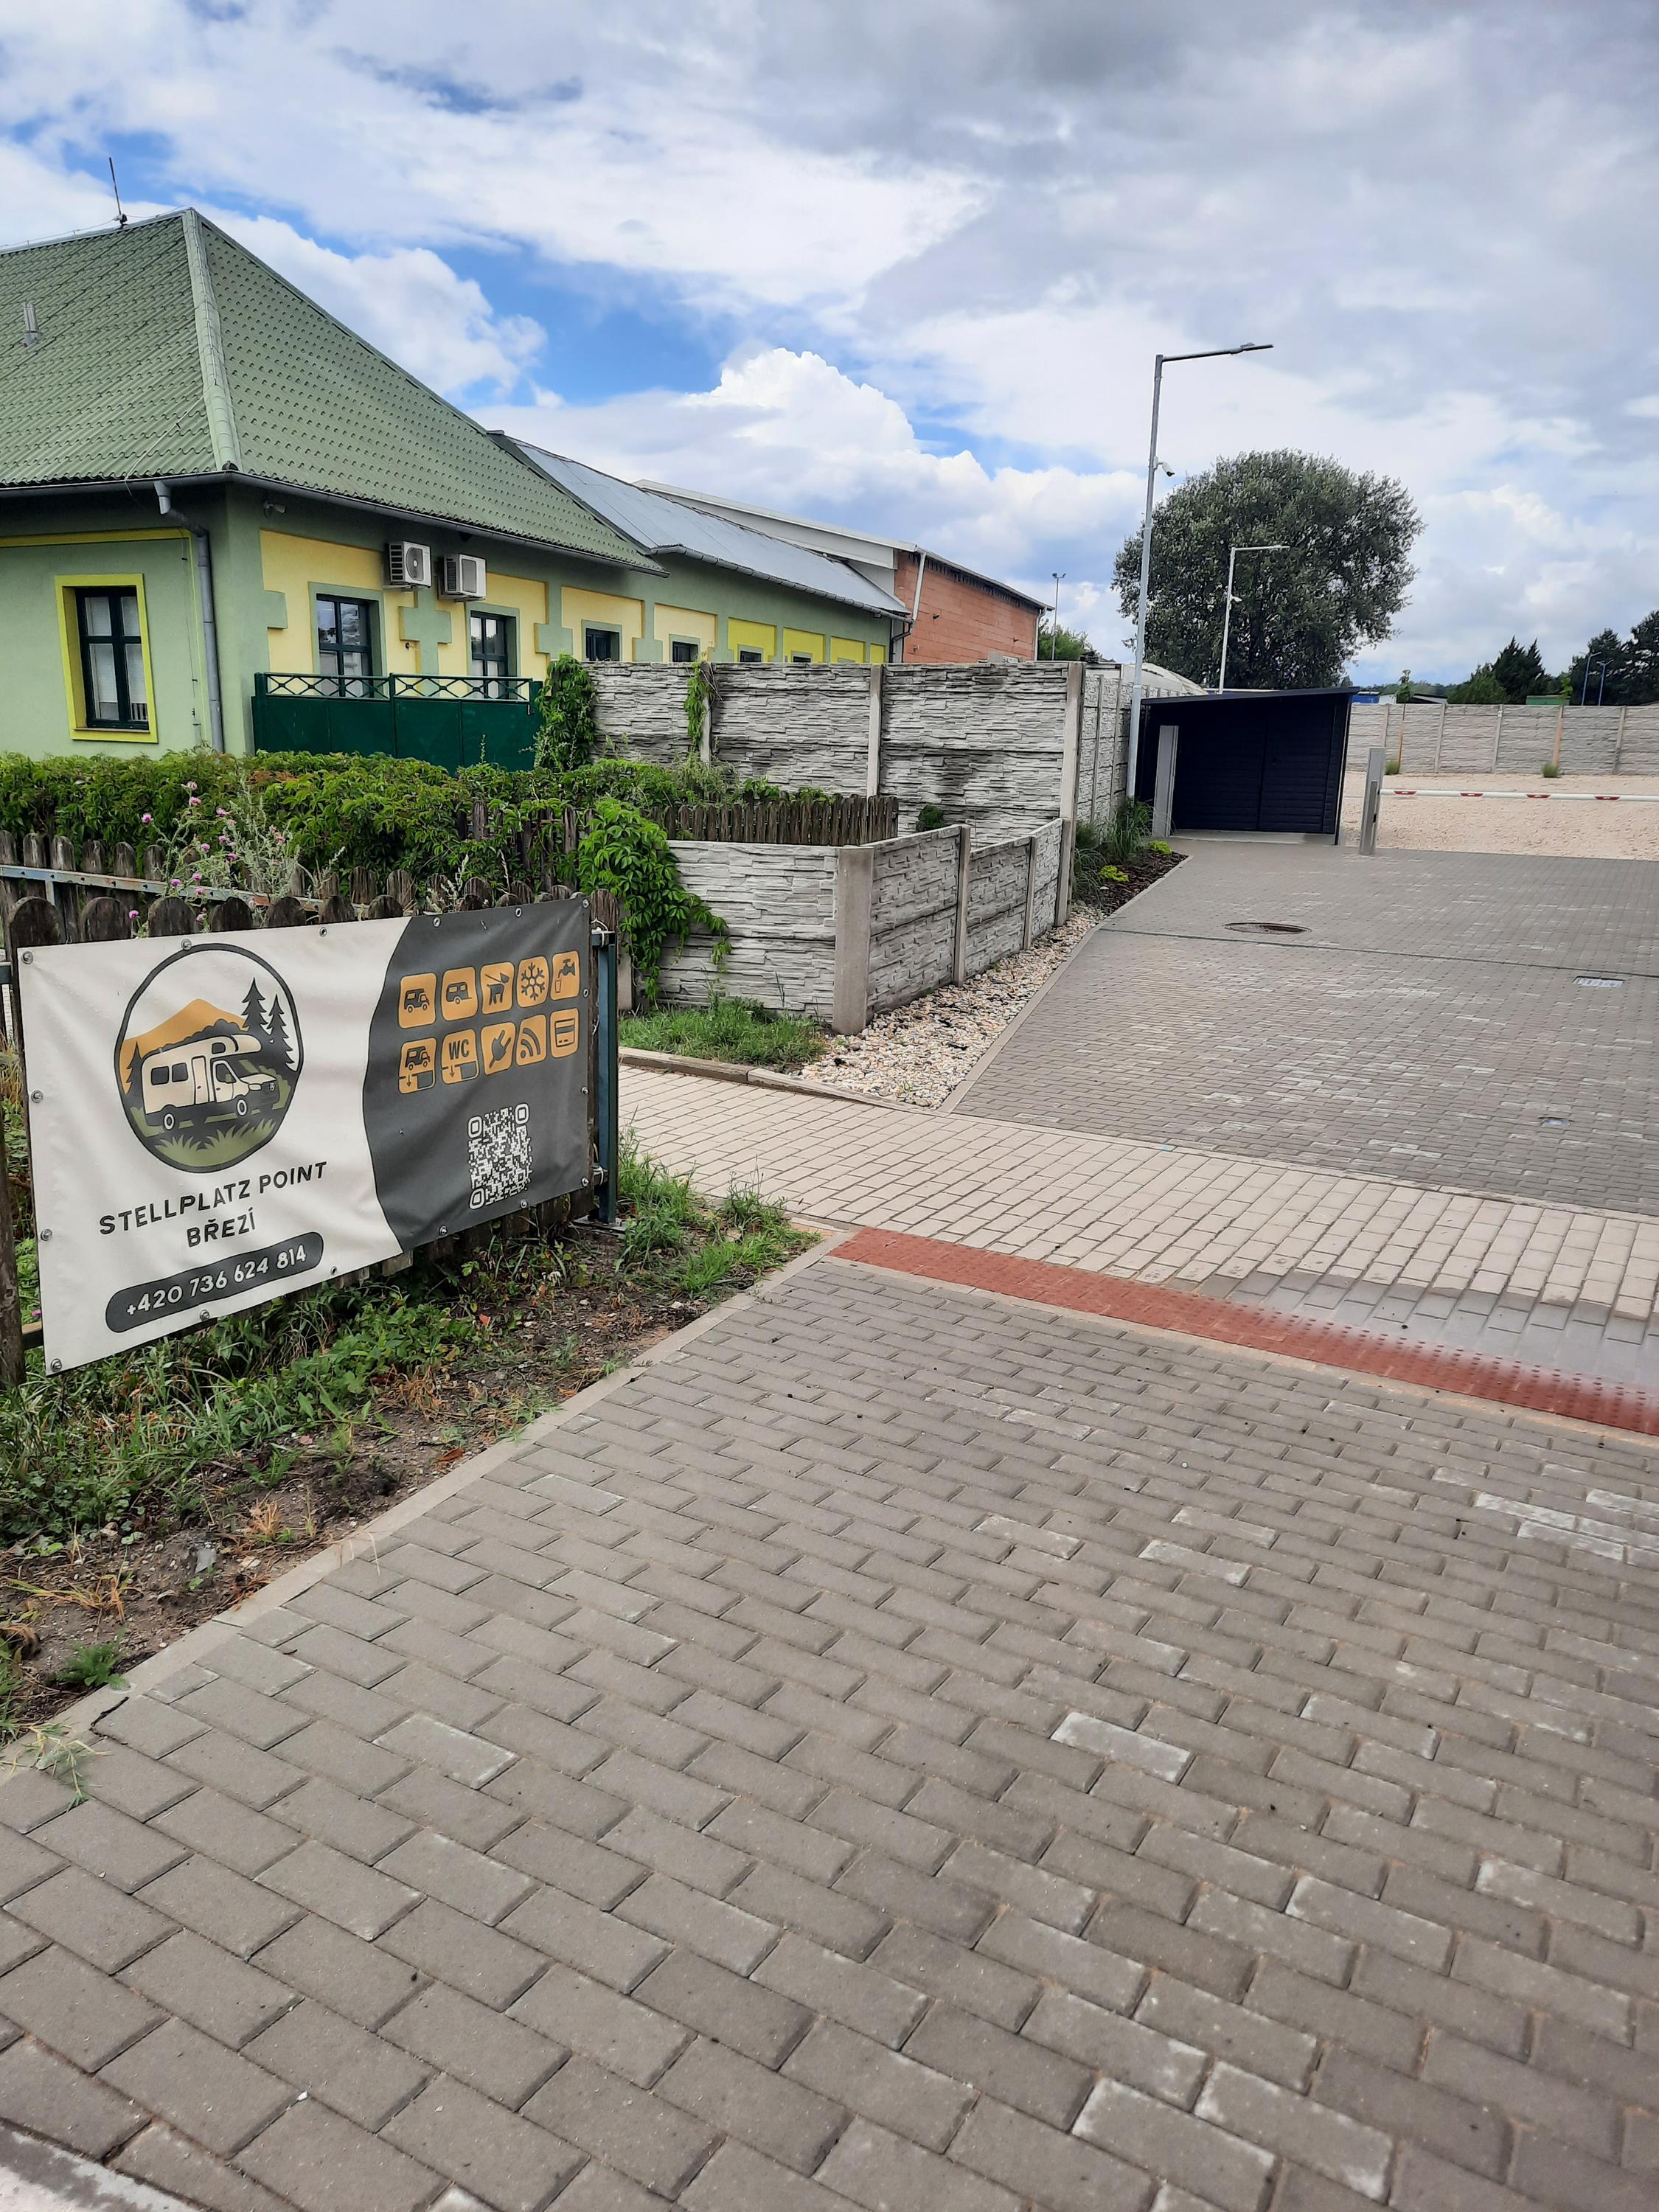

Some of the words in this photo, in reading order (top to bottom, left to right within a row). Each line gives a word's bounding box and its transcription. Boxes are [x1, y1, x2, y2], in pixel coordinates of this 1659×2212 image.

[448, 1038, 470, 1060] WC
[100, 1179, 251, 1235] STELLPLATZ
[259, 1161, 327, 1194] POINT
[187, 1207, 256, 1248] BŘEZÍ
[126, 1285, 183, 1315] +420
[189, 1270, 227, 1298] 736
[234, 1257, 268, 1283] 624
[276, 1244, 307, 1269] 814
